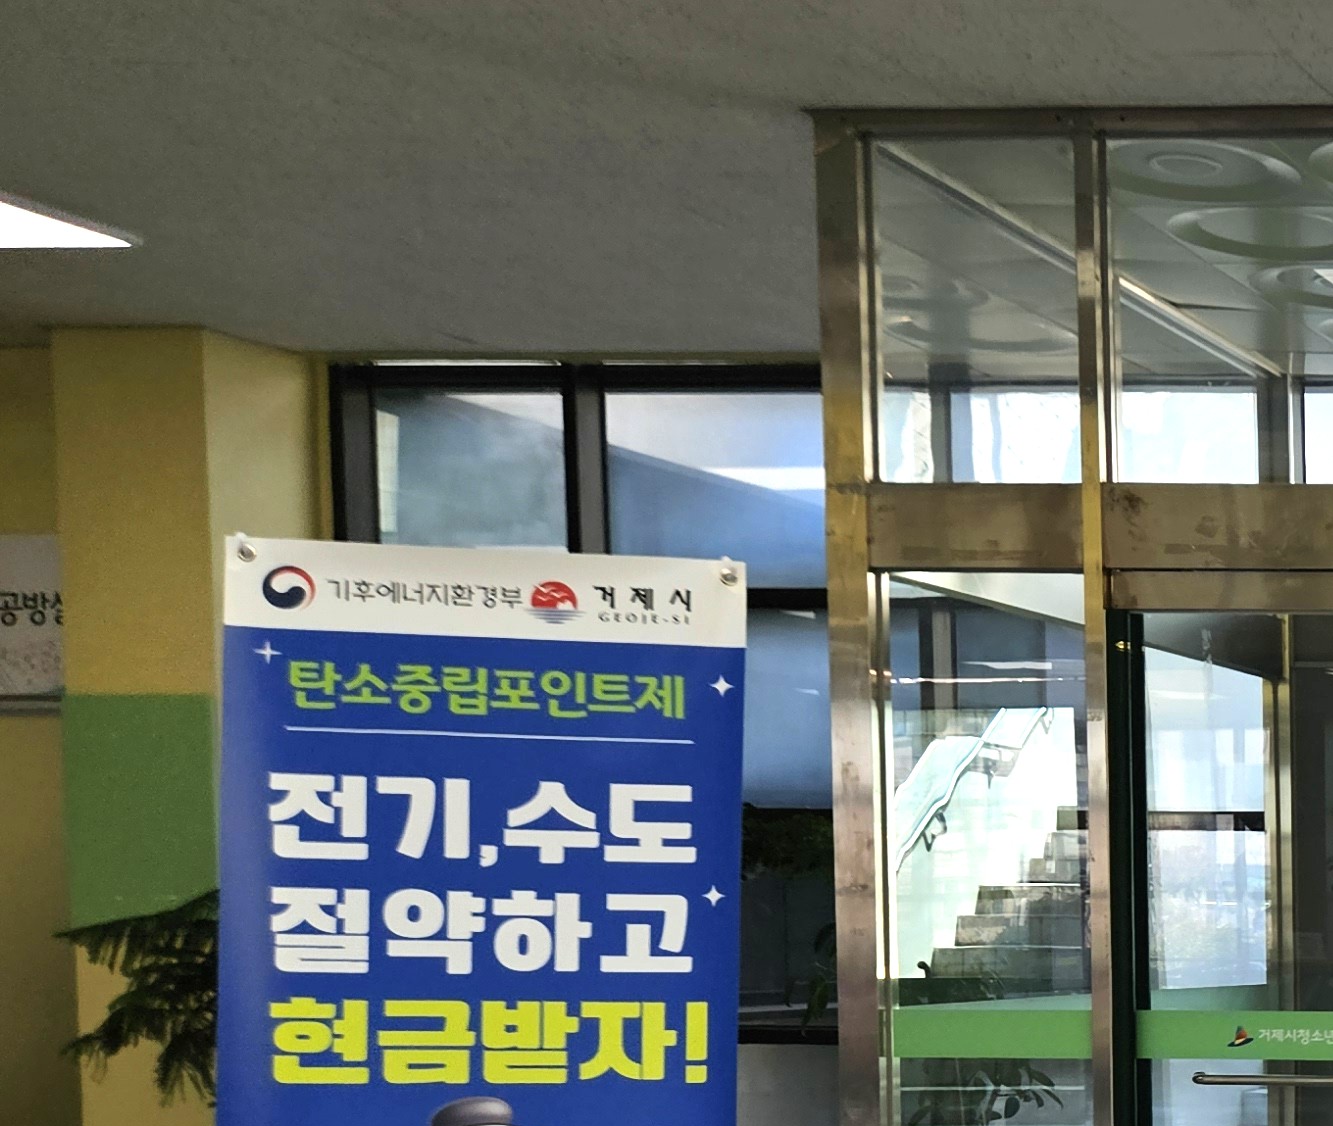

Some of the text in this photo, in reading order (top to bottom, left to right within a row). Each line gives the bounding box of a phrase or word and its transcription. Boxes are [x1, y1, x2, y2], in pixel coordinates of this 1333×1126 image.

[327, 577, 524, 609] 기후에너지환경부
[593, 584, 693, 613] 거제시
[288, 659, 686, 719] 탄소중립포인트제
[268, 771, 698, 869] 전기,수도
[269, 885, 694, 975] 절약하고
[268, 996, 709, 1085] 현금받자!
